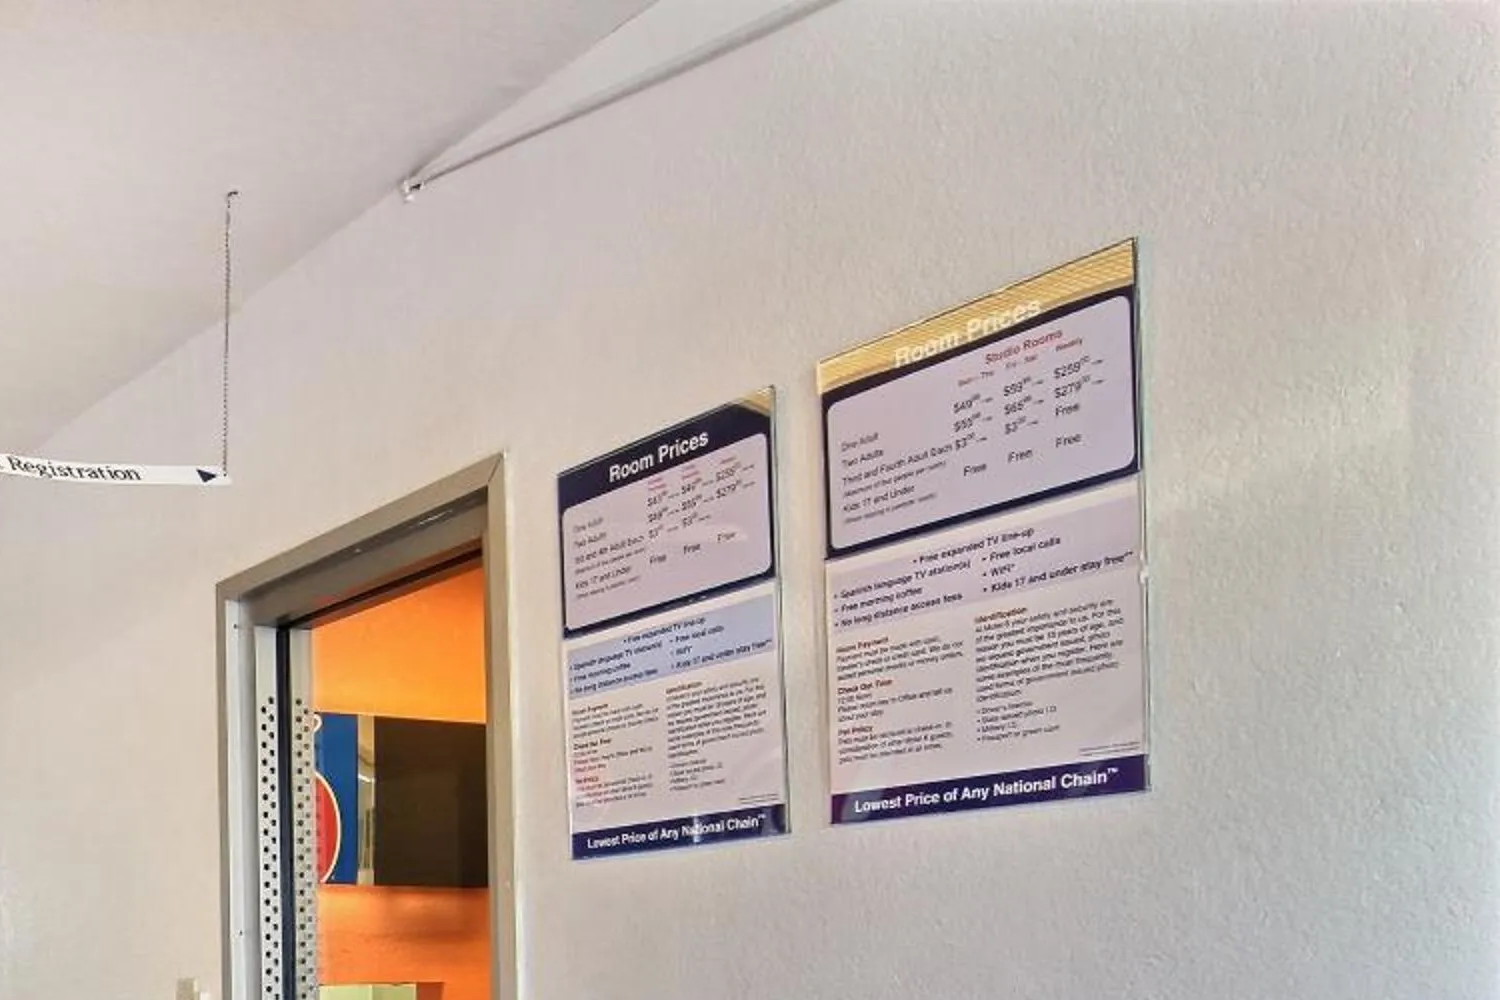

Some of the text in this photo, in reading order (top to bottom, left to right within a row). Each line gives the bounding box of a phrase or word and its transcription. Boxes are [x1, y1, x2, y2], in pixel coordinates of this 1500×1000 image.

[892, 299, 1042, 368] Room Prices
[985, 329, 1062, 364] Studio Rooms
[1055, 433, 1081, 448] Free
[8, 453, 142, 483] Registration
[609, 431, 709, 483] Room Prices
[941, 539, 984, 559] expanded
[986, 536, 999, 547] TV
[1001, 529, 1034, 543] line-up
[989, 536, 1061, 561] Free local calls
[915, 568, 927, 580] TV
[991, 579, 1012, 593] Kids
[1015, 574, 1026, 587] 17
[1028, 570, 1047, 584] and
[1049, 565, 1077, 580] under
[841, 602, 858, 613] Free
[853, 613, 872, 624] long
[855, 798, 901, 813] Lowest
[905, 793, 939, 806] Price
[944, 790, 958, 802] of
[961, 787, 989, 801] Any
[993, 776, 1055, 796] National
[587, 834, 619, 849] Lowest
[622, 831, 646, 845] Price
[649, 827, 660, 840] of
[660, 825, 679, 840] Any
